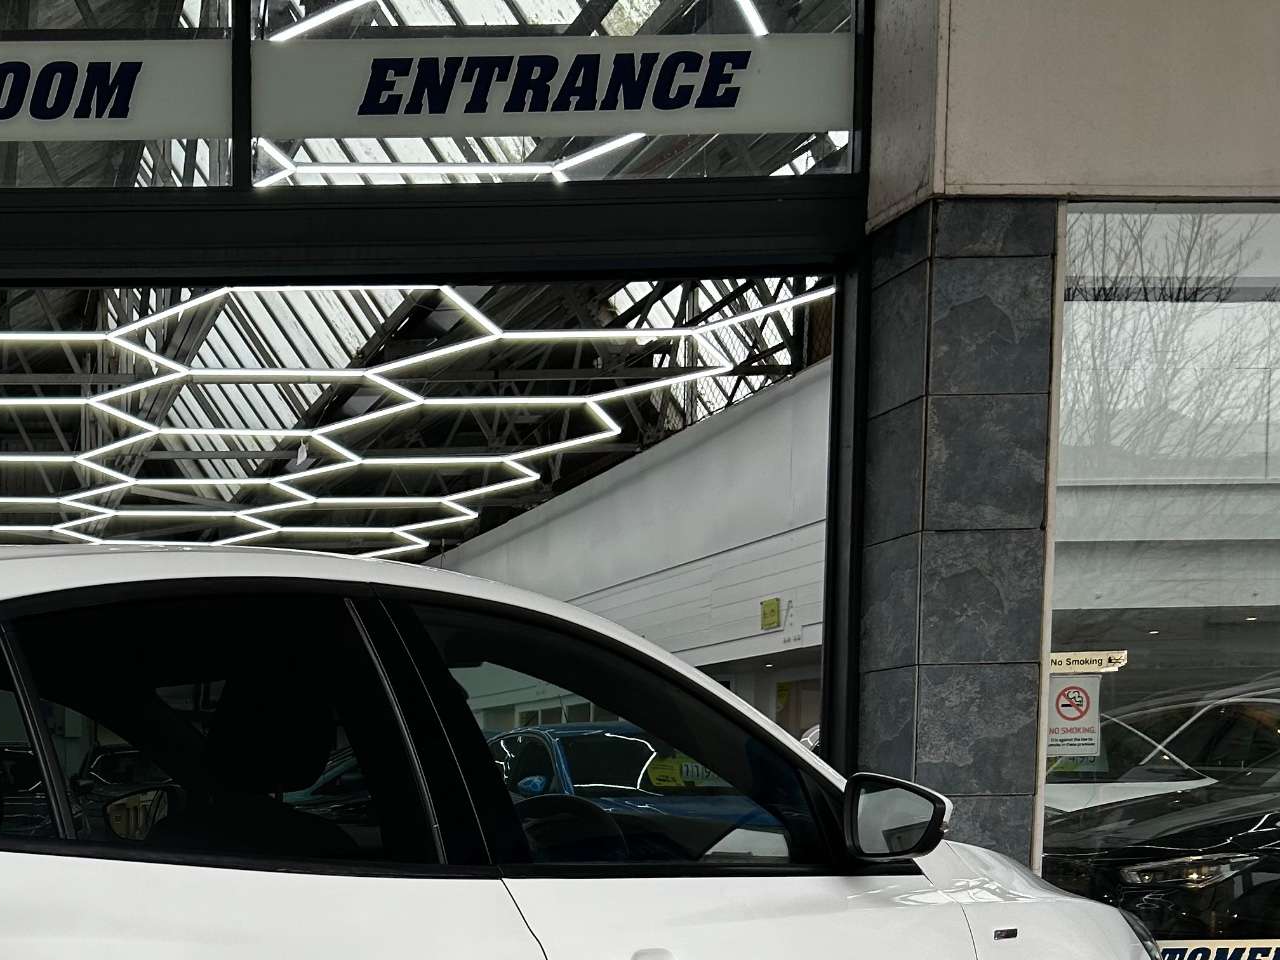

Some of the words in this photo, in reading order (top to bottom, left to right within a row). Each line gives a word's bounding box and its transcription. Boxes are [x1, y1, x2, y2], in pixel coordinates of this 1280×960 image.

[357, 50, 752, 115] ENTRANCE
[1065, 658, 1103, 666] Smoking
[1049, 727, 1060, 735] NO
